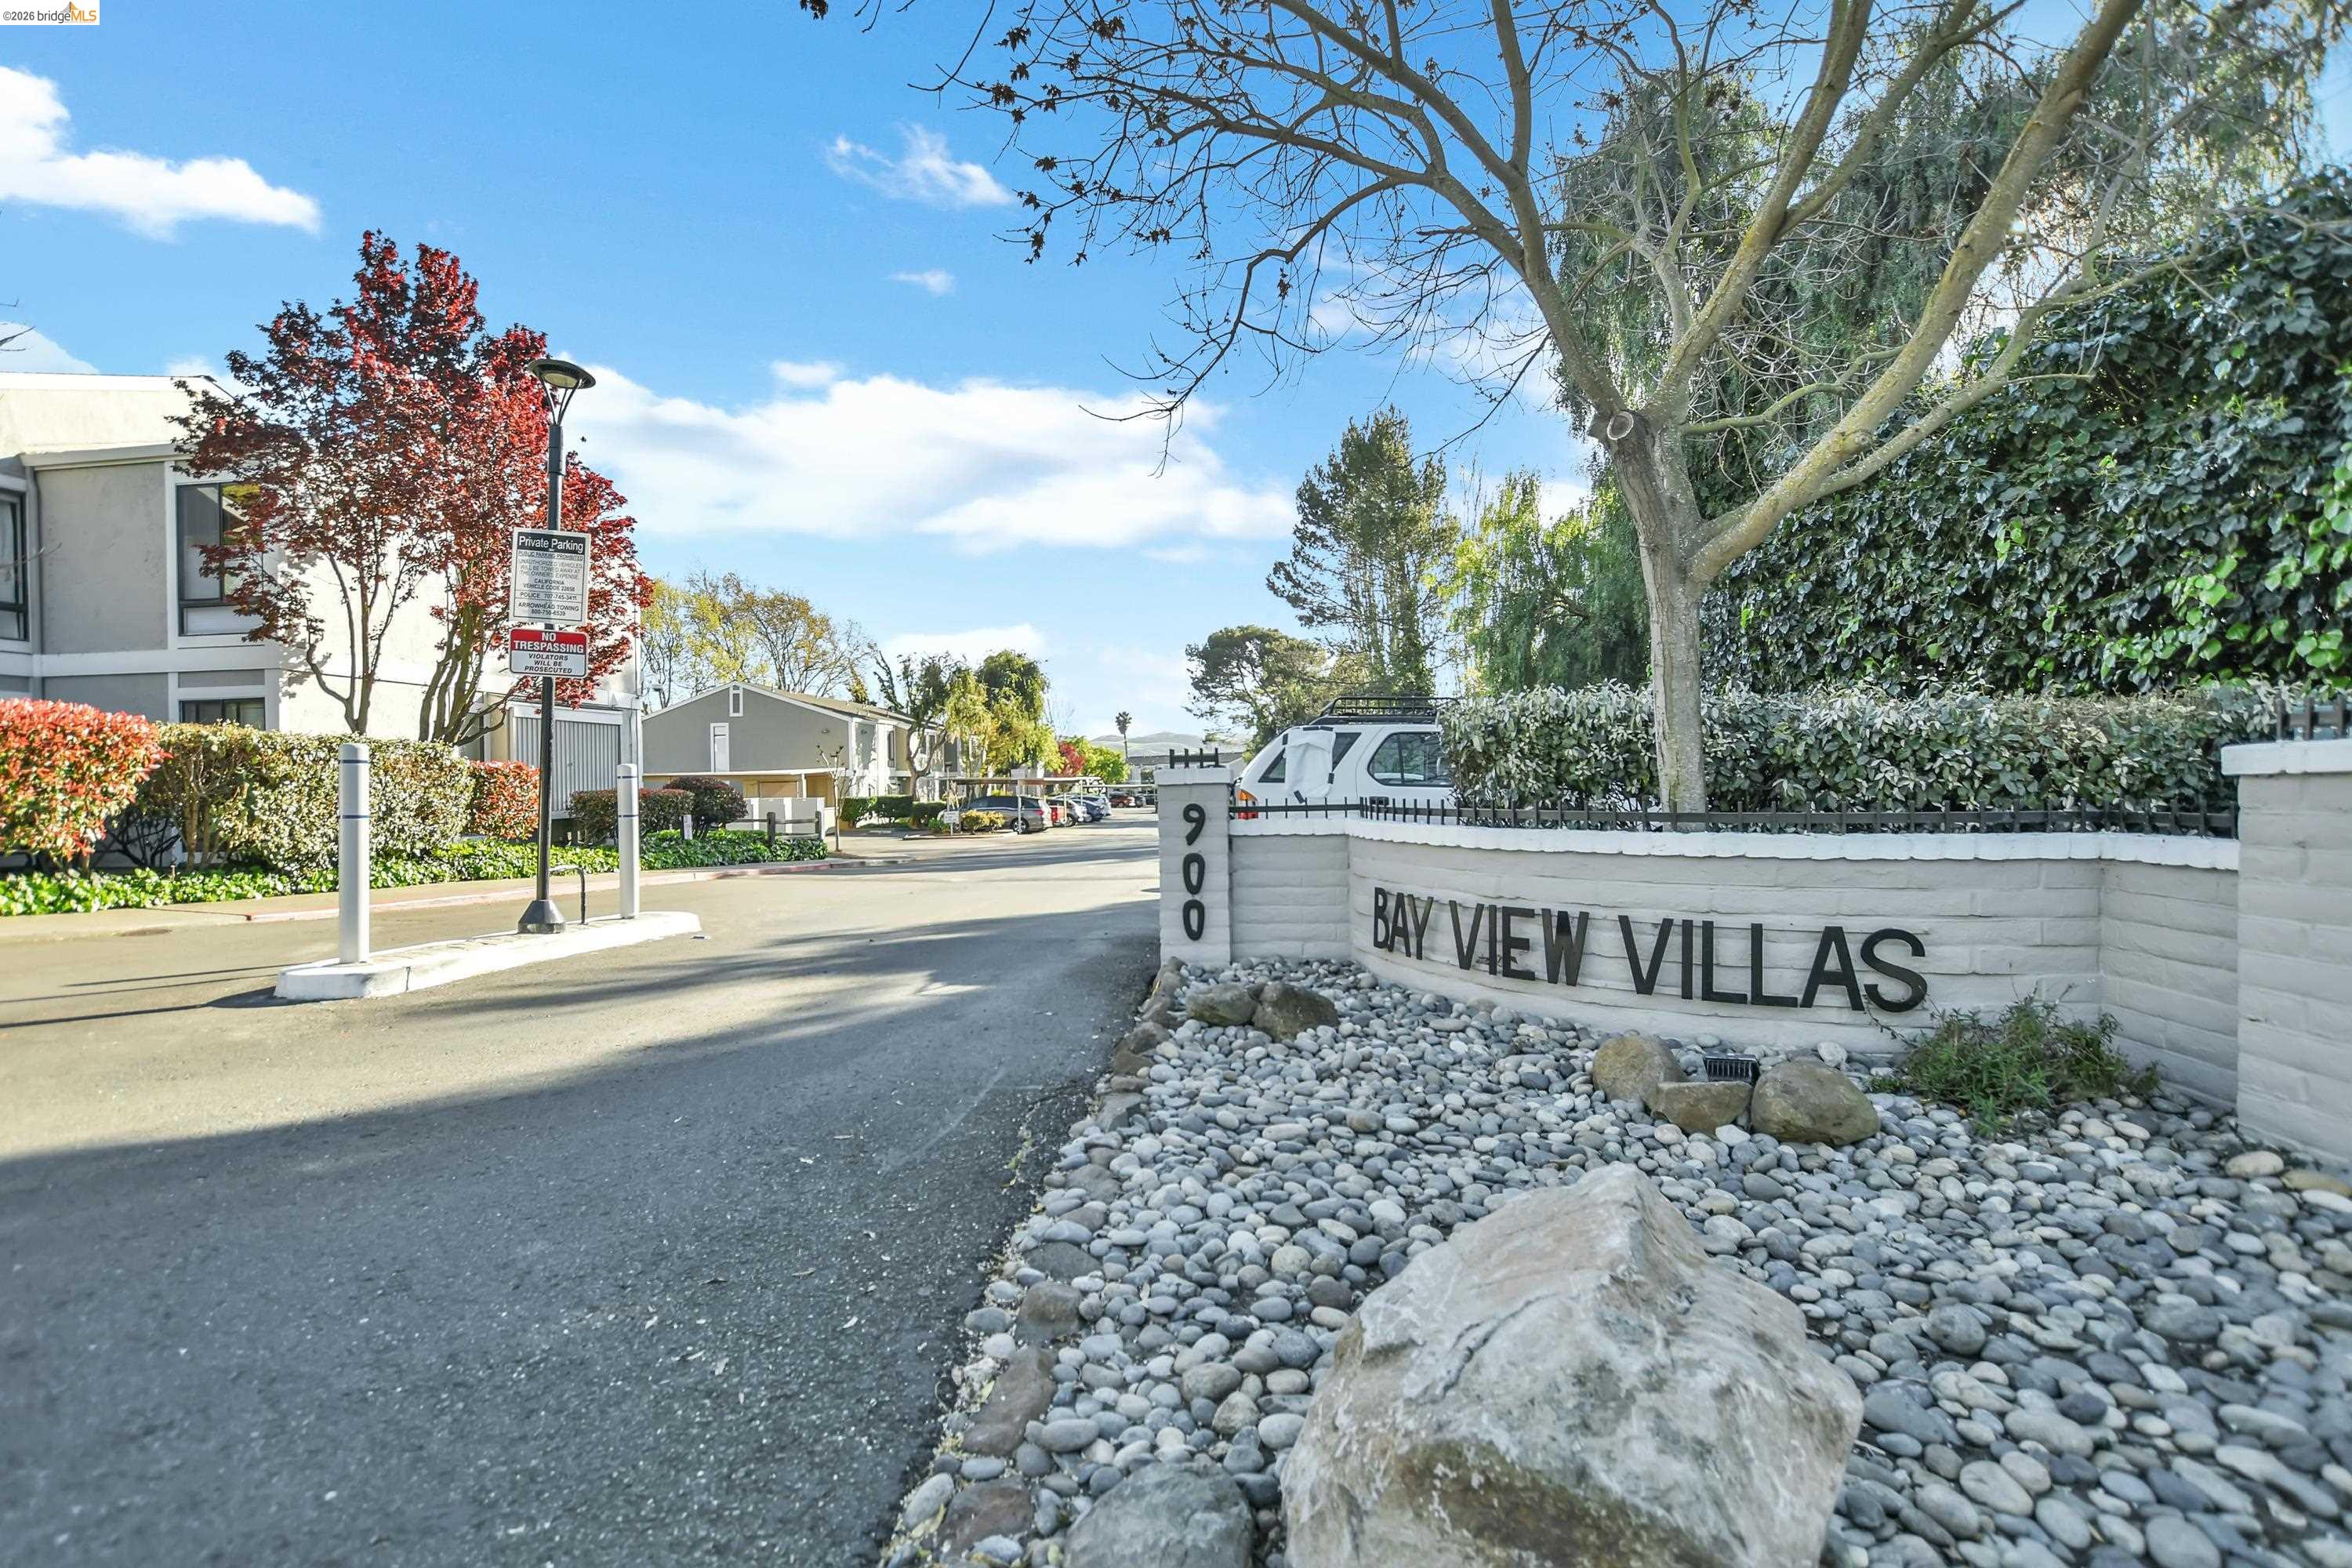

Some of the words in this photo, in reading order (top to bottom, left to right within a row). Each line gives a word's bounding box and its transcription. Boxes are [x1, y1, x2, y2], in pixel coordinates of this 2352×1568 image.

[519, 535, 549, 548] Private
[551, 539, 583, 554] Parking
[542, 632, 557, 641] NO
[514, 641, 584, 653] TRESPASSING
[1182, 803, 1206, 942] 900
[1374, 887, 1434, 960] BAY
[1449, 899, 1589, 986] VIEW
[1618, 914, 1928, 1012] VILLAS
